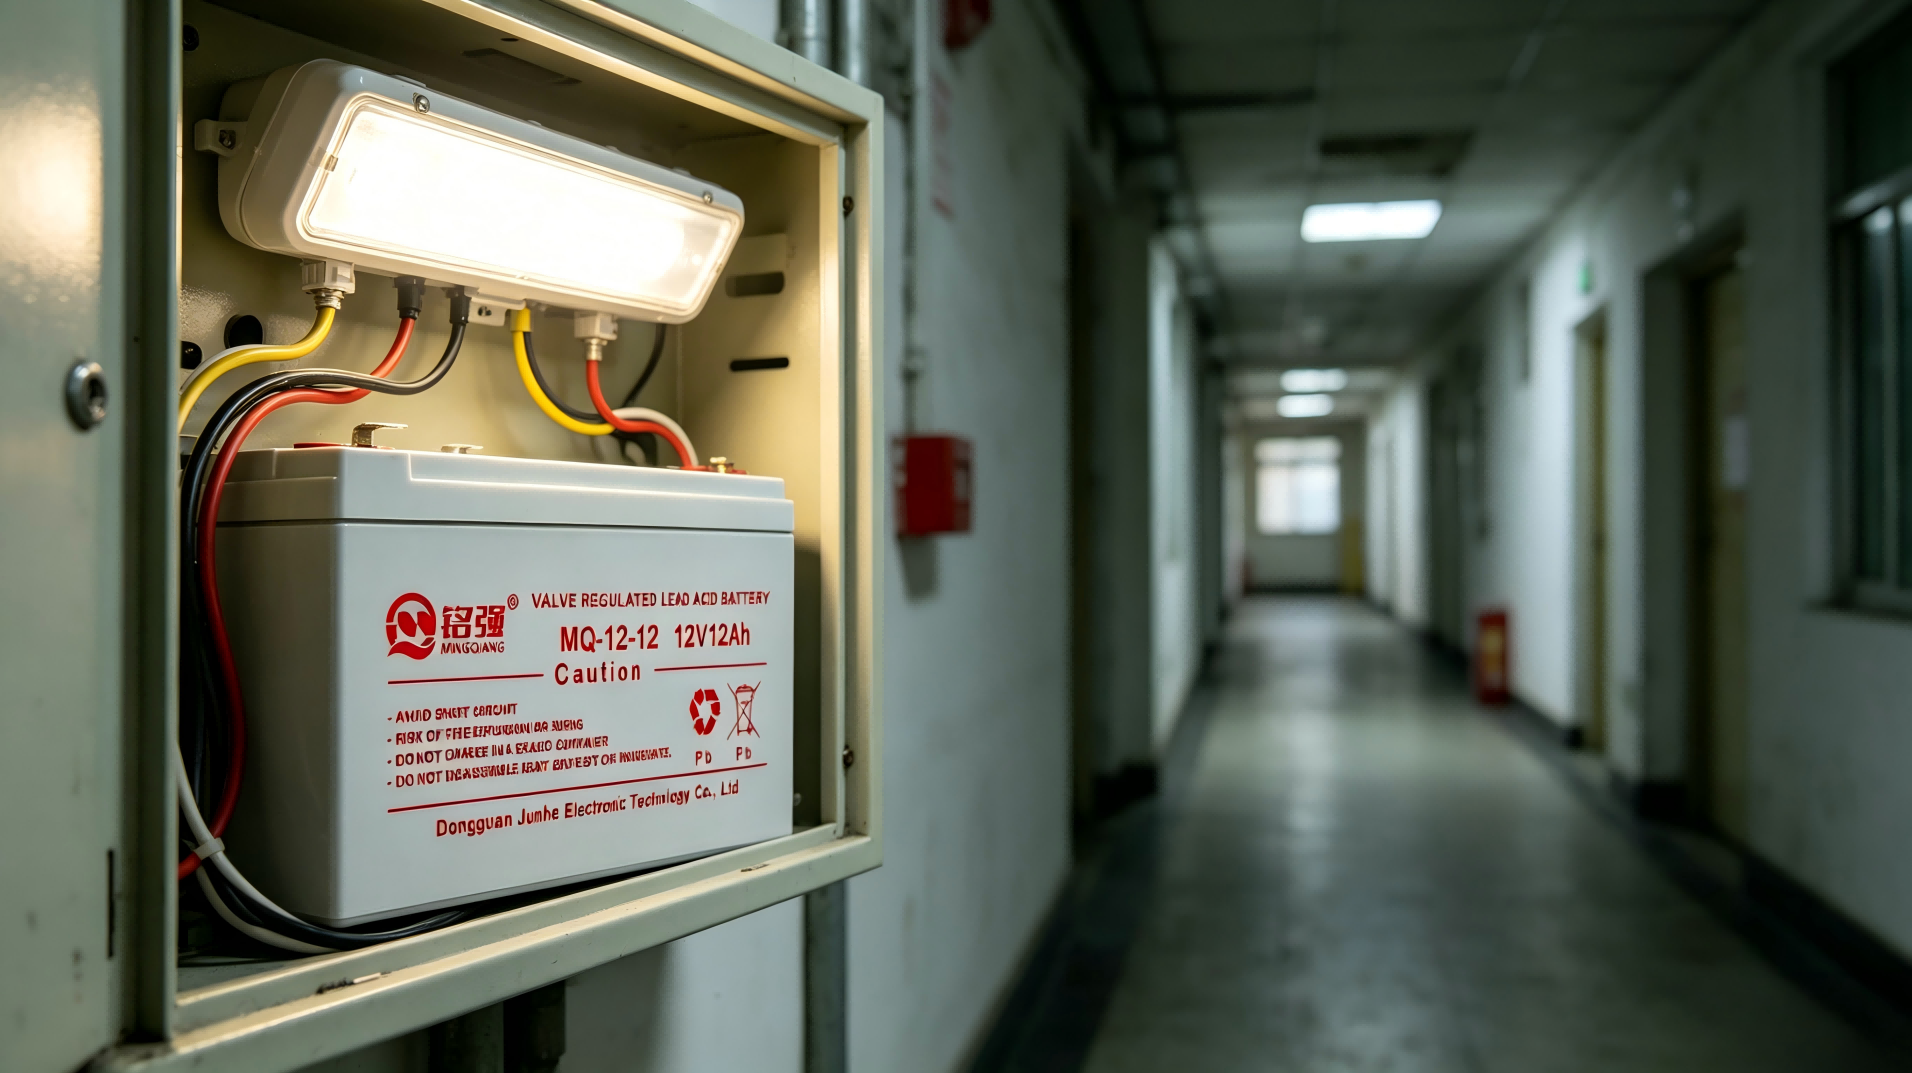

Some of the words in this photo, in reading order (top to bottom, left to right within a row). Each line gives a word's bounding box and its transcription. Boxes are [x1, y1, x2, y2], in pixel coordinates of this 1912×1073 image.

[532, 593, 576, 609] VALVE
[581, 592, 656, 608] REGULATED
[661, 592, 690, 606] LEAD
[693, 592, 718, 606] ACID
[721, 591, 770, 605] BATTERY
[440, 605, 506, 639] 铭强
[560, 624, 659, 653] MQ-12-12
[674, 622, 750, 648] 12V12Ah
[554, 661, 640, 685] Caution
[396, 753, 416, 766] DO
[415, 750, 442, 764] NOT
[695, 750, 712, 765] Pb
[736, 747, 751, 760] Pb
[396, 774, 414, 788] DO
[417, 771, 443, 785] NOT
[436, 814, 512, 837] Dongguan
